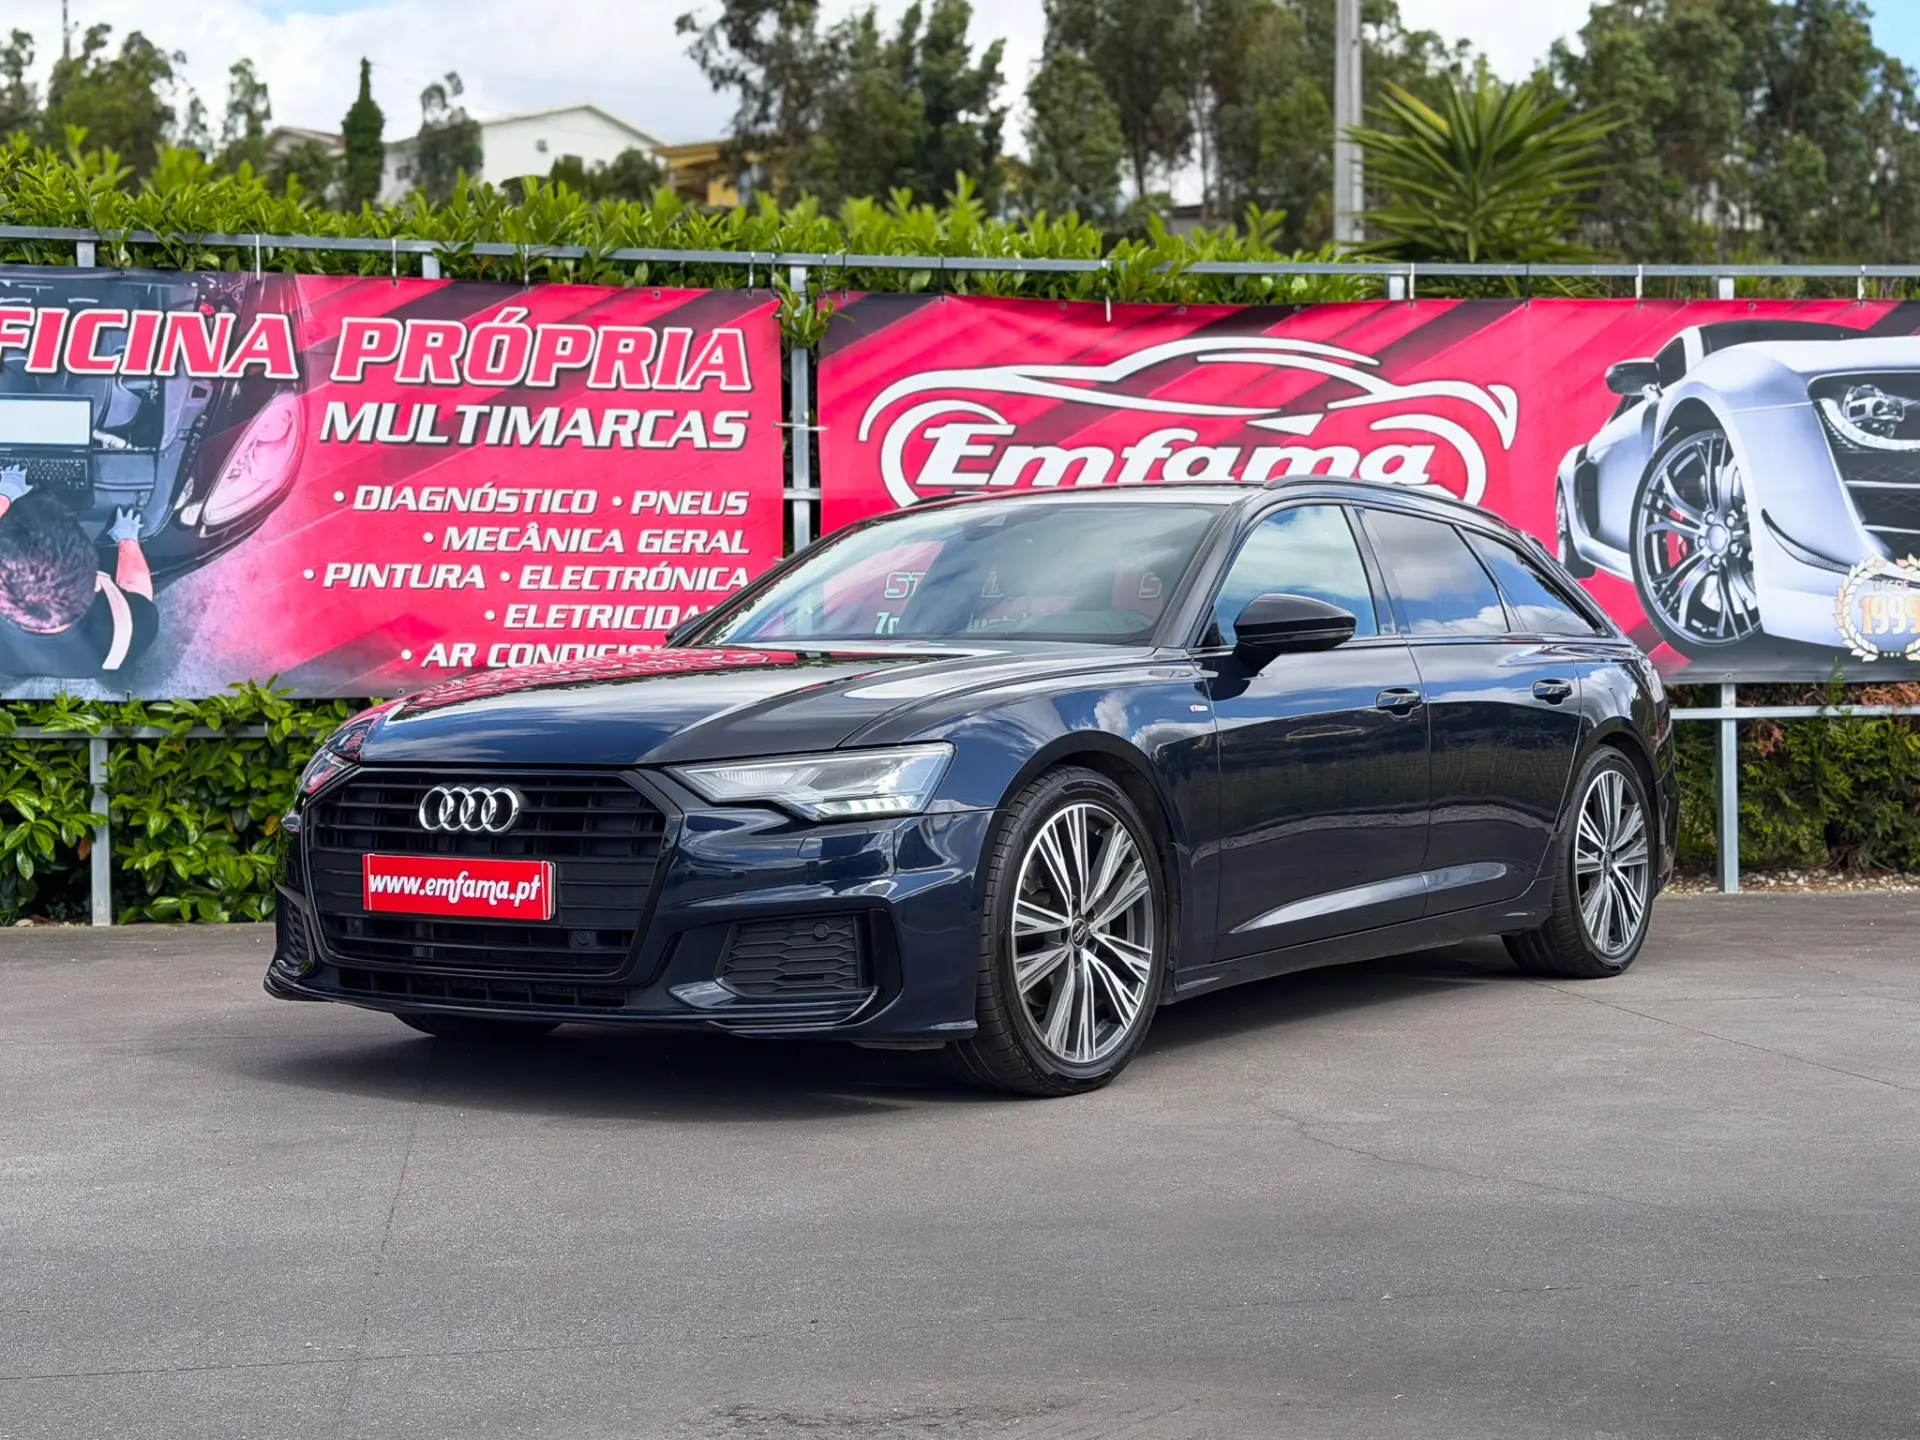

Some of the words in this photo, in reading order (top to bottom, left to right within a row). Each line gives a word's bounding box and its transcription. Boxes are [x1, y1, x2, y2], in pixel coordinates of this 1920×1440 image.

[330, 307, 752, 391] PRÓPRIA
[320, 402, 749, 449] MULTIMARCAS
[915, 423, 1436, 487] Emfama
[353, 482, 597, 515] DIAGNÓSTICO
[631, 490, 750, 516] PNEUS
[442, 522, 624, 554] MECÂNICA
[637, 529, 750, 554] GERAL
[323, 563, 485, 590] PINTURA
[518, 561, 749, 592] ELECTRÓNICA
[503, 604, 715, 630] ELETRICID
[1858, 595, 1920, 635] 1999
[421, 643, 477, 668] AR
[370, 871, 541, 907] www.emfama.pt
